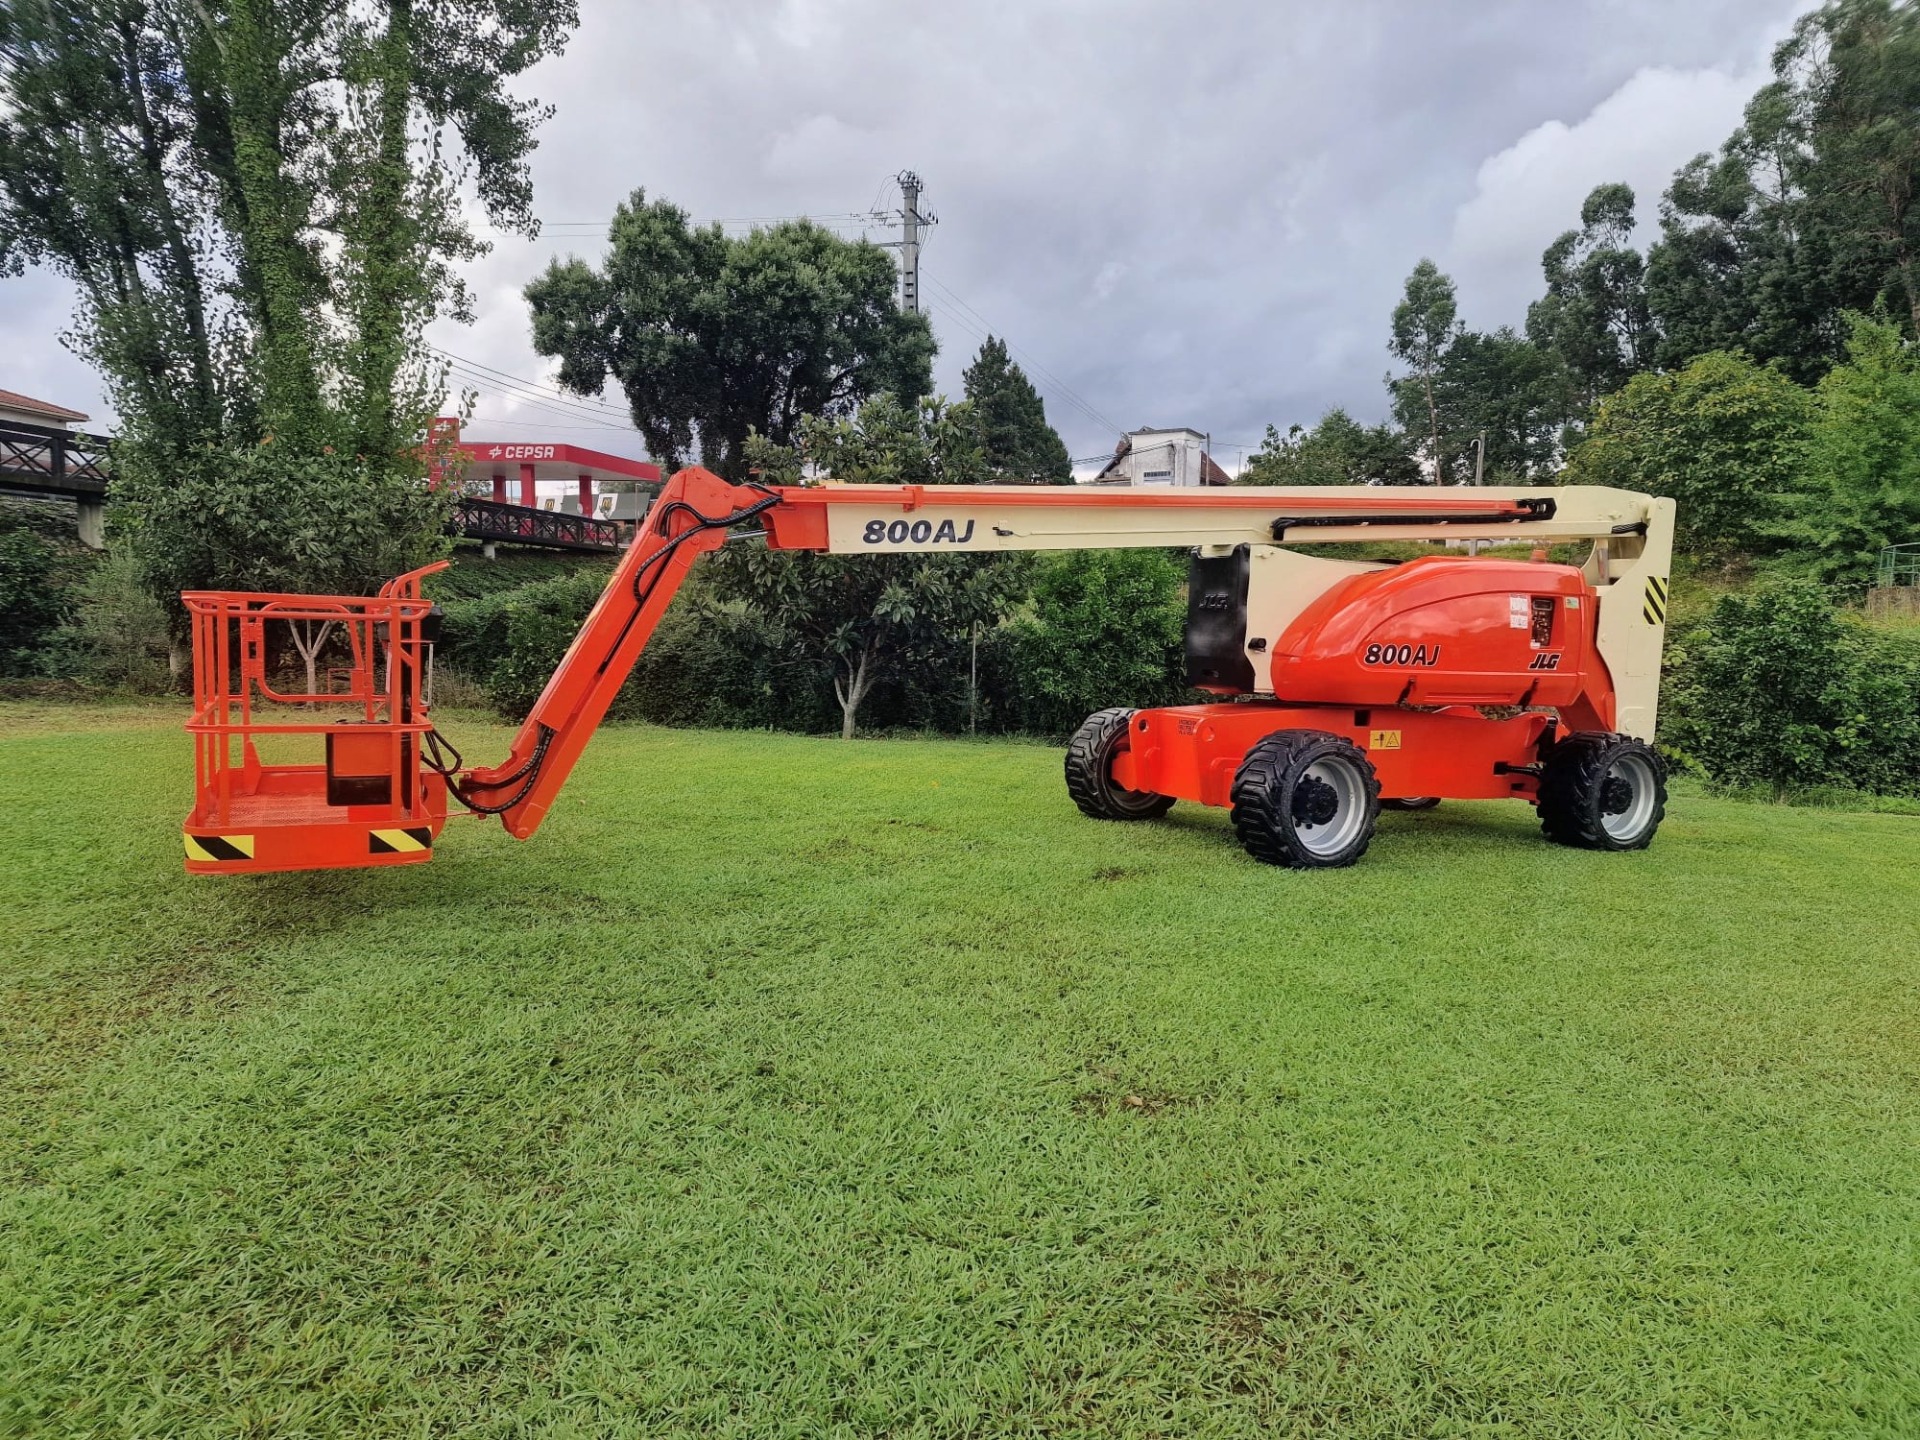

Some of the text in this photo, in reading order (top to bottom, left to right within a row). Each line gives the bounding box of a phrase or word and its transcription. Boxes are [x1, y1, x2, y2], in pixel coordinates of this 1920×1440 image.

[505, 446, 554, 458] CEPSA
[862, 519, 975, 544] 800AJ
[1364, 643, 1441, 666] 800AJ
[1528, 653, 1561, 670] JLG
